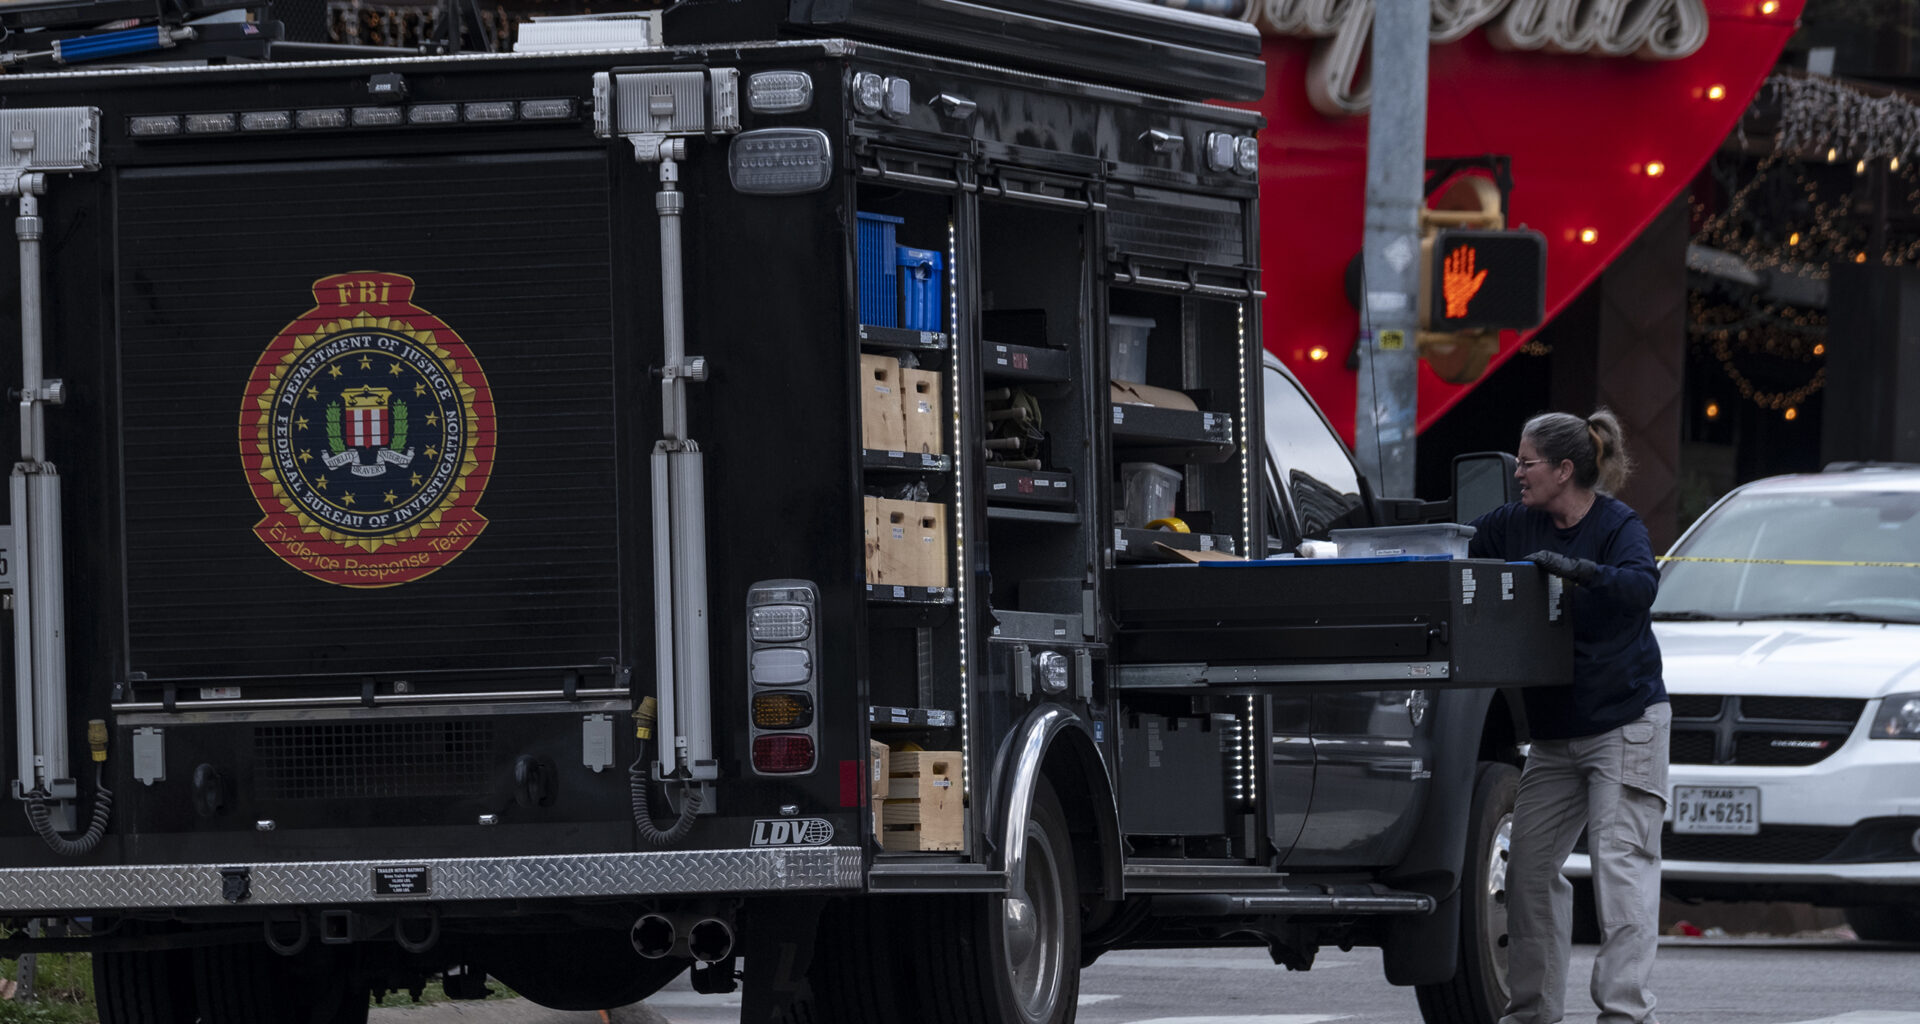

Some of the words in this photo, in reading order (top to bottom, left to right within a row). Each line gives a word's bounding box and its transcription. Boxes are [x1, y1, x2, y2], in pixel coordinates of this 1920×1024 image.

[336, 281, 392, 306] FBI
[282, 336, 372, 405] DEPARTMENT
[378, 337, 399, 350] OF
[401, 341, 451, 400] JUSTICE
[277, 415, 302, 491] FEDERAL
[303, 491, 364, 527] BUREAU
[369, 515, 389, 528] OF
[395, 410, 458, 523] INVESTIGATION
[327, 452, 355, 467] FIDELITY
[353, 464, 384, 475] BRAVERY
[380, 451, 409, 465] INTEGRITY
[269, 521, 339, 571] Evidence
[345, 553, 430, 580] Response
[428, 518, 473, 556] Team
[1702, 790, 1734, 799] TEXAS
[754, 820, 810, 845] LDV
